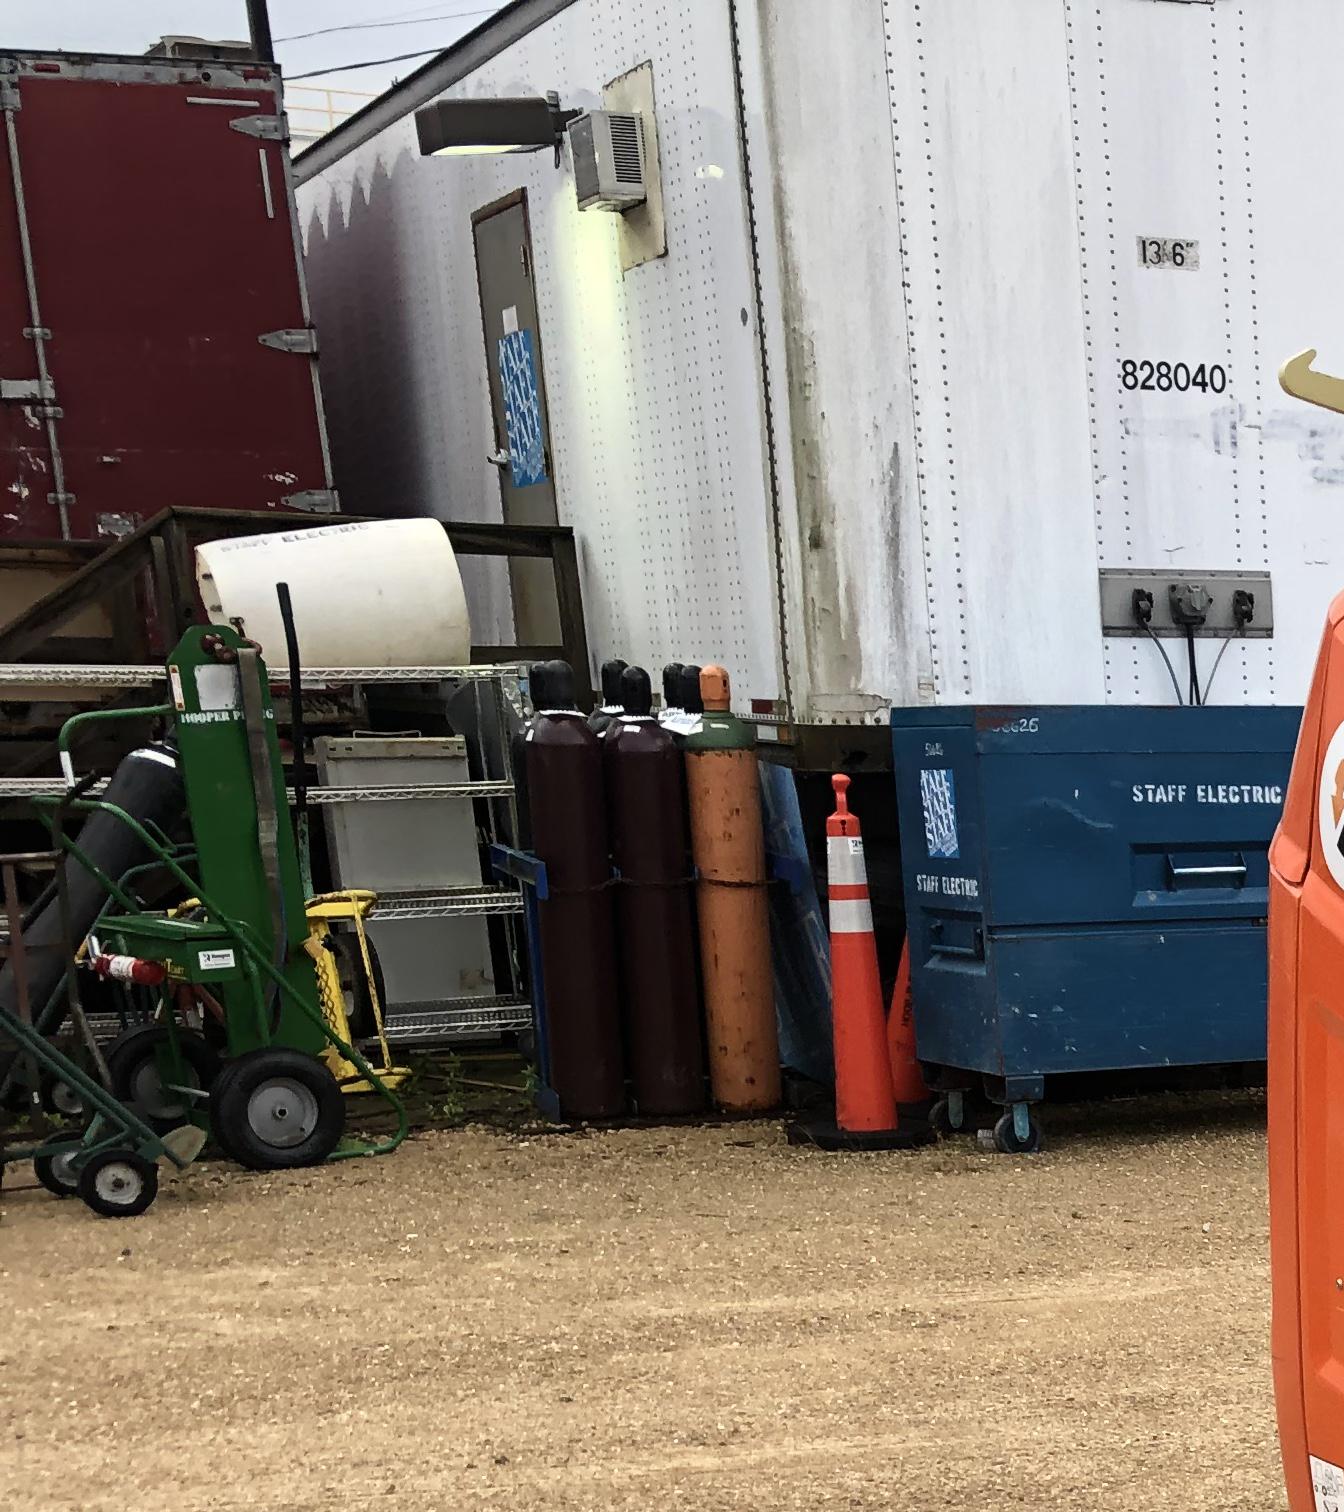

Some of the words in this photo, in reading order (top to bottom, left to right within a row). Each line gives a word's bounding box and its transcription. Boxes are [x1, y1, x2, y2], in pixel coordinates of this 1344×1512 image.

[1121, 359, 1227, 394] 828040
[1132, 783, 1187, 803] STAFF
[1196, 783, 1282, 804] ELECTRIC
[916, 873, 939, 893] STAFF
[941, 876, 979, 897] ELECTRIC
